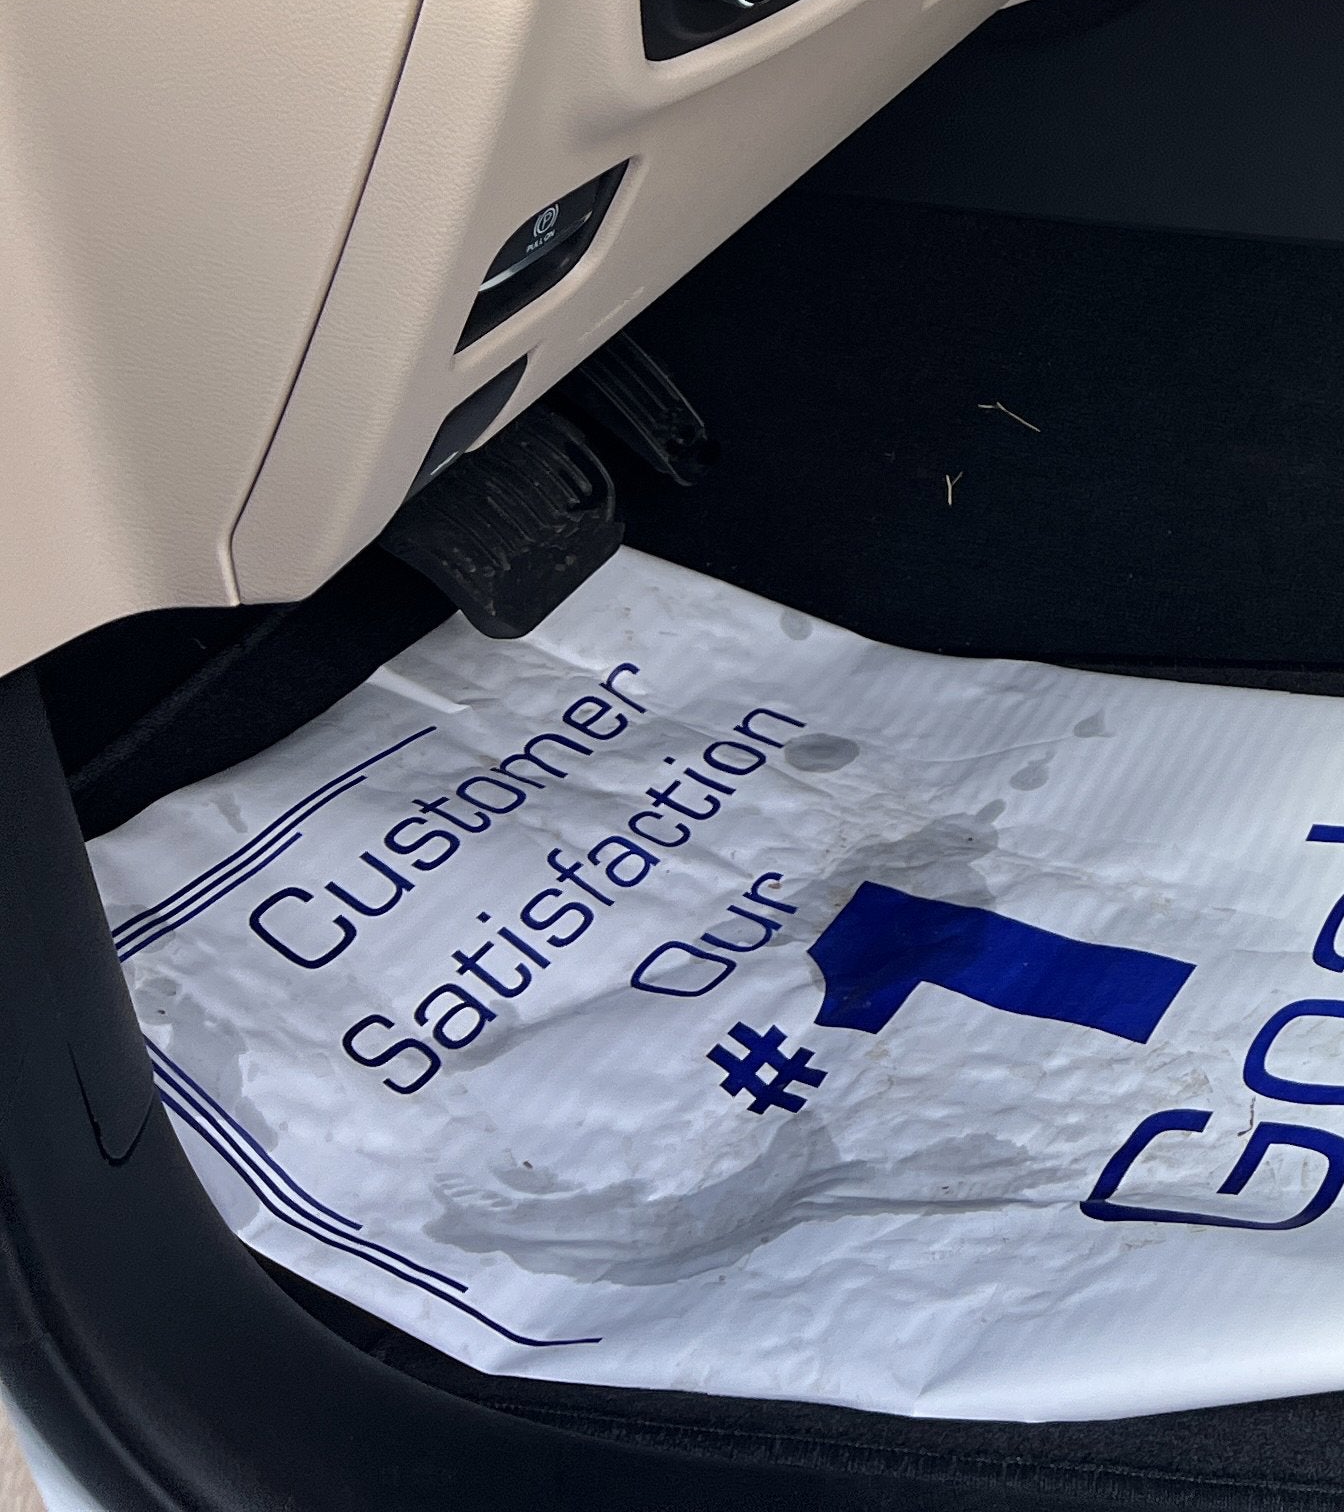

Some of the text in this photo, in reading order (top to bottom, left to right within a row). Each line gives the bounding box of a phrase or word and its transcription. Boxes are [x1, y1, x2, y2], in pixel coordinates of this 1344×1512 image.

[248, 661, 650, 970] Customer
[341, 704, 808, 1096] Satisfaction
[630, 871, 798, 997] Our
